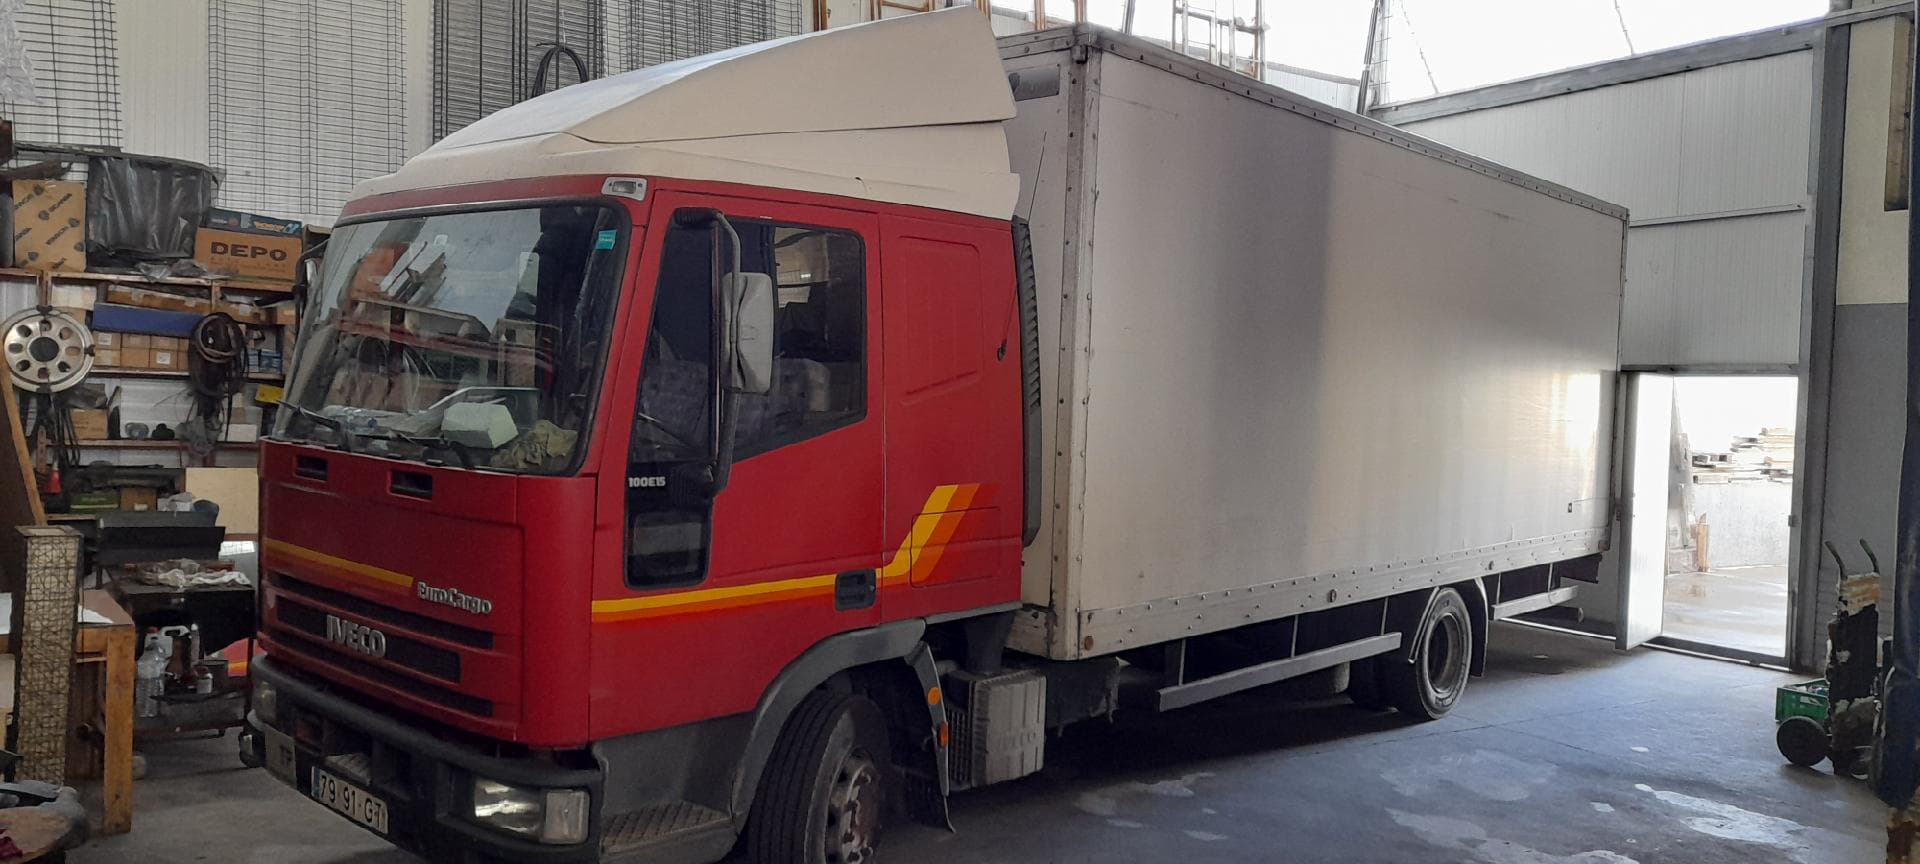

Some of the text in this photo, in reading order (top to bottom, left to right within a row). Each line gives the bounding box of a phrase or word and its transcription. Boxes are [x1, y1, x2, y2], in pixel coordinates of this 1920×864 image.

[211, 241, 287, 261] DEPO
[628, 476, 666, 487] 100E15
[417, 581, 493, 614] EuroCargo
[326, 614, 387, 657] IVECO
